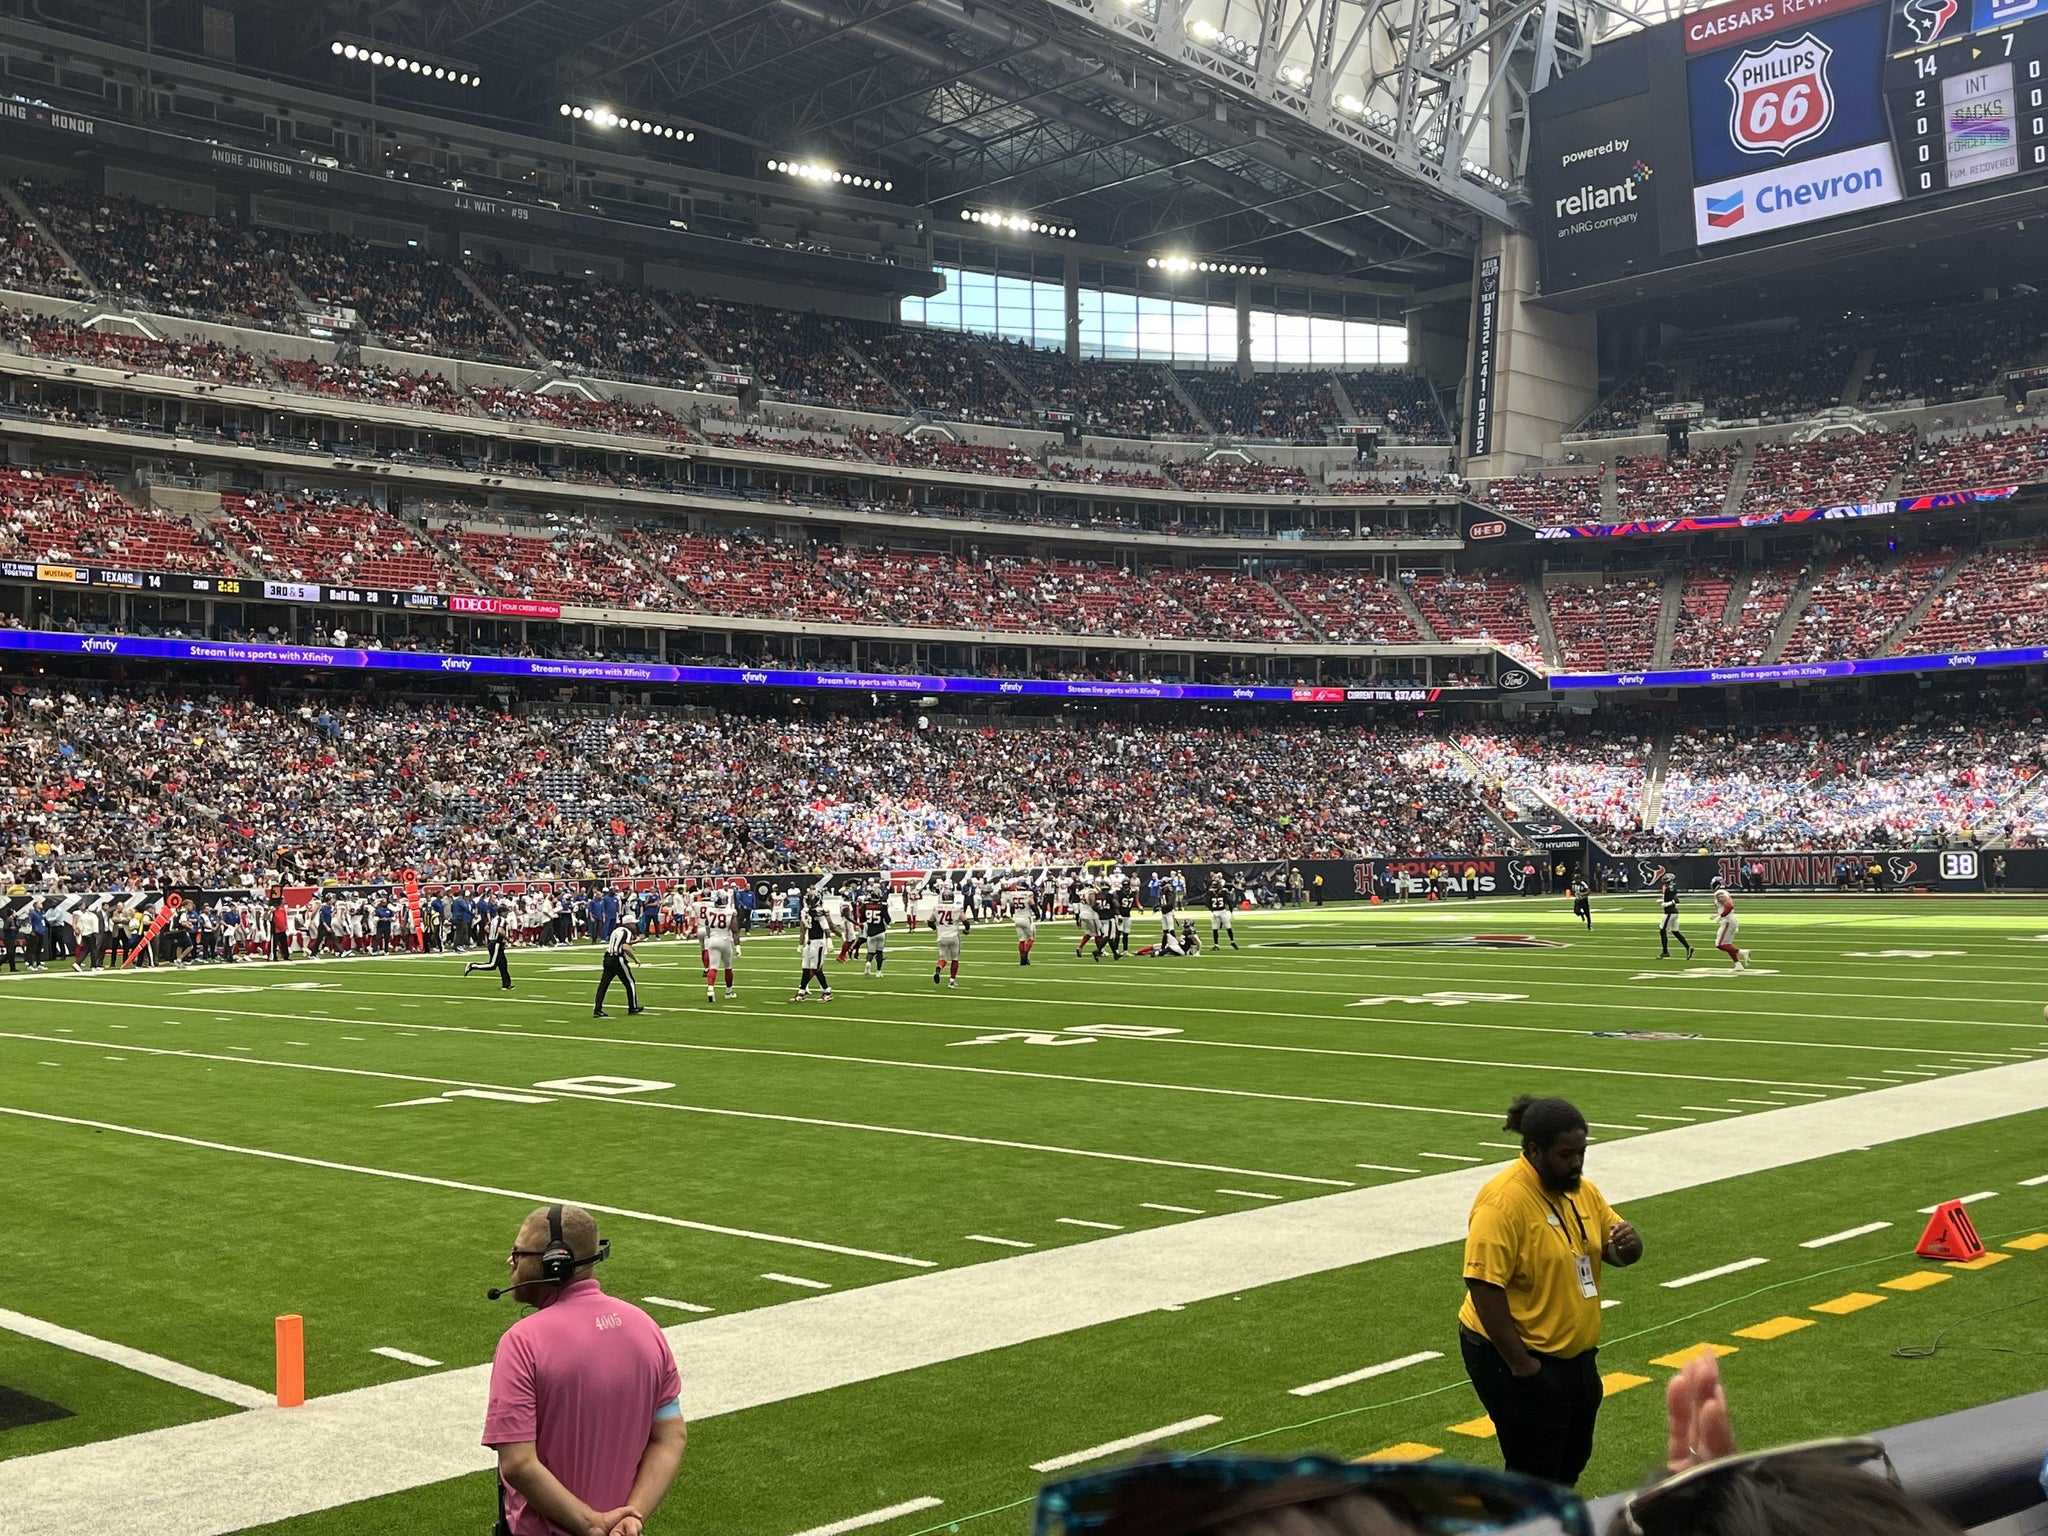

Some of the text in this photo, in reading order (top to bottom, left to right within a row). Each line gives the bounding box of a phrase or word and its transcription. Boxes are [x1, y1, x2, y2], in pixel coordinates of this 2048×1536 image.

[1691, 4, 1774, 40] CAESARS
[2002, 34, 2014, 56] 7
[1743, 52, 1815, 86] PHILLIPS
[1915, 55, 1937, 79] 14
[2029, 60, 2040, 78] 0
[1966, 75, 1988, 94] INT
[1916, 90, 1926, 107] 2
[2031, 88, 2042, 106] 0
[1750, 84, 1811, 134] 66
[51, 113, 94, 135] HONOR
[1917, 118, 1927, 134] 0
[2033, 117, 2043, 135] 0
[1562, 139, 1629, 168] powered by
[1919, 145, 1929, 162] 0
[2035, 146, 2045, 163] 0
[211, 149, 328, 183] ANDRE JOHNSON #80
[1969, 157, 2015, 175] RECOVERED
[1921, 172, 1931, 189] 0
[1556, 177, 1638, 218] reliant
[1756, 167, 1882, 214] Chevron
[455, 198, 529, 220] J.J. WATT #99
[1558, 212, 1638, 238] an NRG company
[101, 571, 134, 583] TEXANS
[149, 576, 161, 588] 14
[217, 581, 240, 593] 2:25
[298, 588, 305, 598] 5
[329, 590, 345, 600] Ball
[347, 591, 360, 601] On
[392, 594, 399, 605] 7
[411, 594, 438, 606] GIANTS
[453, 597, 499, 612] TDECU
[518, 605, 538, 613] CREDIT
[81, 637, 118, 653] xfinity
[190, 645, 334, 665] Stream live sports with Xfinity
[1948, 655, 1977, 667] xfinity
[441, 658, 472, 671] xfinity
[531, 664, 651, 679] Stream live sports with Xfinity
[742, 672, 768, 683] xfinity
[1504, 672, 1524, 686] Ford
[1711, 667, 1827, 682] Stream live sports with Xfinity
[817, 676, 922, 690] Stream live sports with Xfinity
[1068, 685, 1090, 693] Stream
[1104, 687, 1122, 696] sports
[1124, 688, 1138, 696] with
[1139, 687, 1160, 697] Xfinity
[1347, 691, 1374, 700] CURRENT
[1376, 691, 1392, 700] TOTAL
[1395, 690, 1426, 701] $37,454
[1546, 841, 1579, 849] HYUNDAI
[1946, 855, 1973, 875] 38
[709, 913, 727, 929] 78
[865, 910, 881, 924] 95
[938, 910, 954, 926] 74
[595, 1312, 622, 1332] 4005
